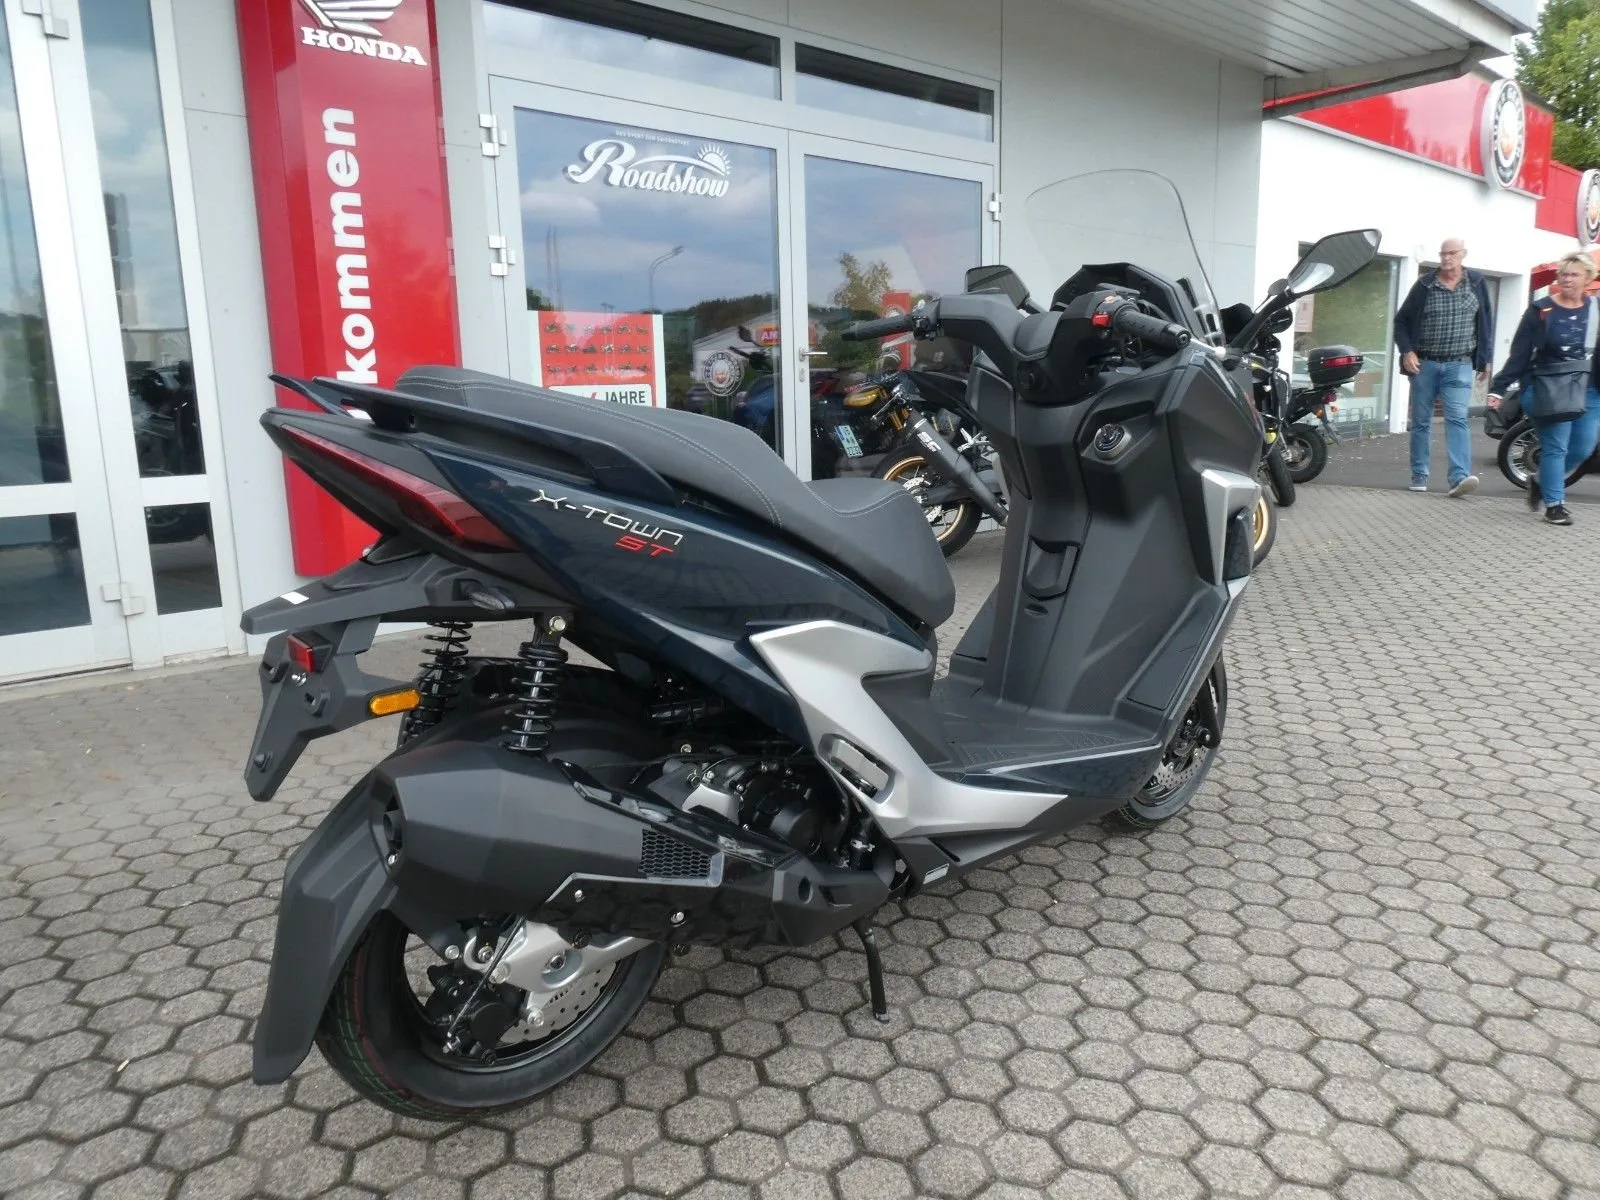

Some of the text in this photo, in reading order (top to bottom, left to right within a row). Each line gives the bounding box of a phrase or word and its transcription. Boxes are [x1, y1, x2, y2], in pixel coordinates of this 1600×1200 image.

[300, 26, 428, 67] HONDA
[567, 139, 730, 198] Roadshow
[322, 107, 378, 384] kommen
[615, 535, 674, 557] ST
